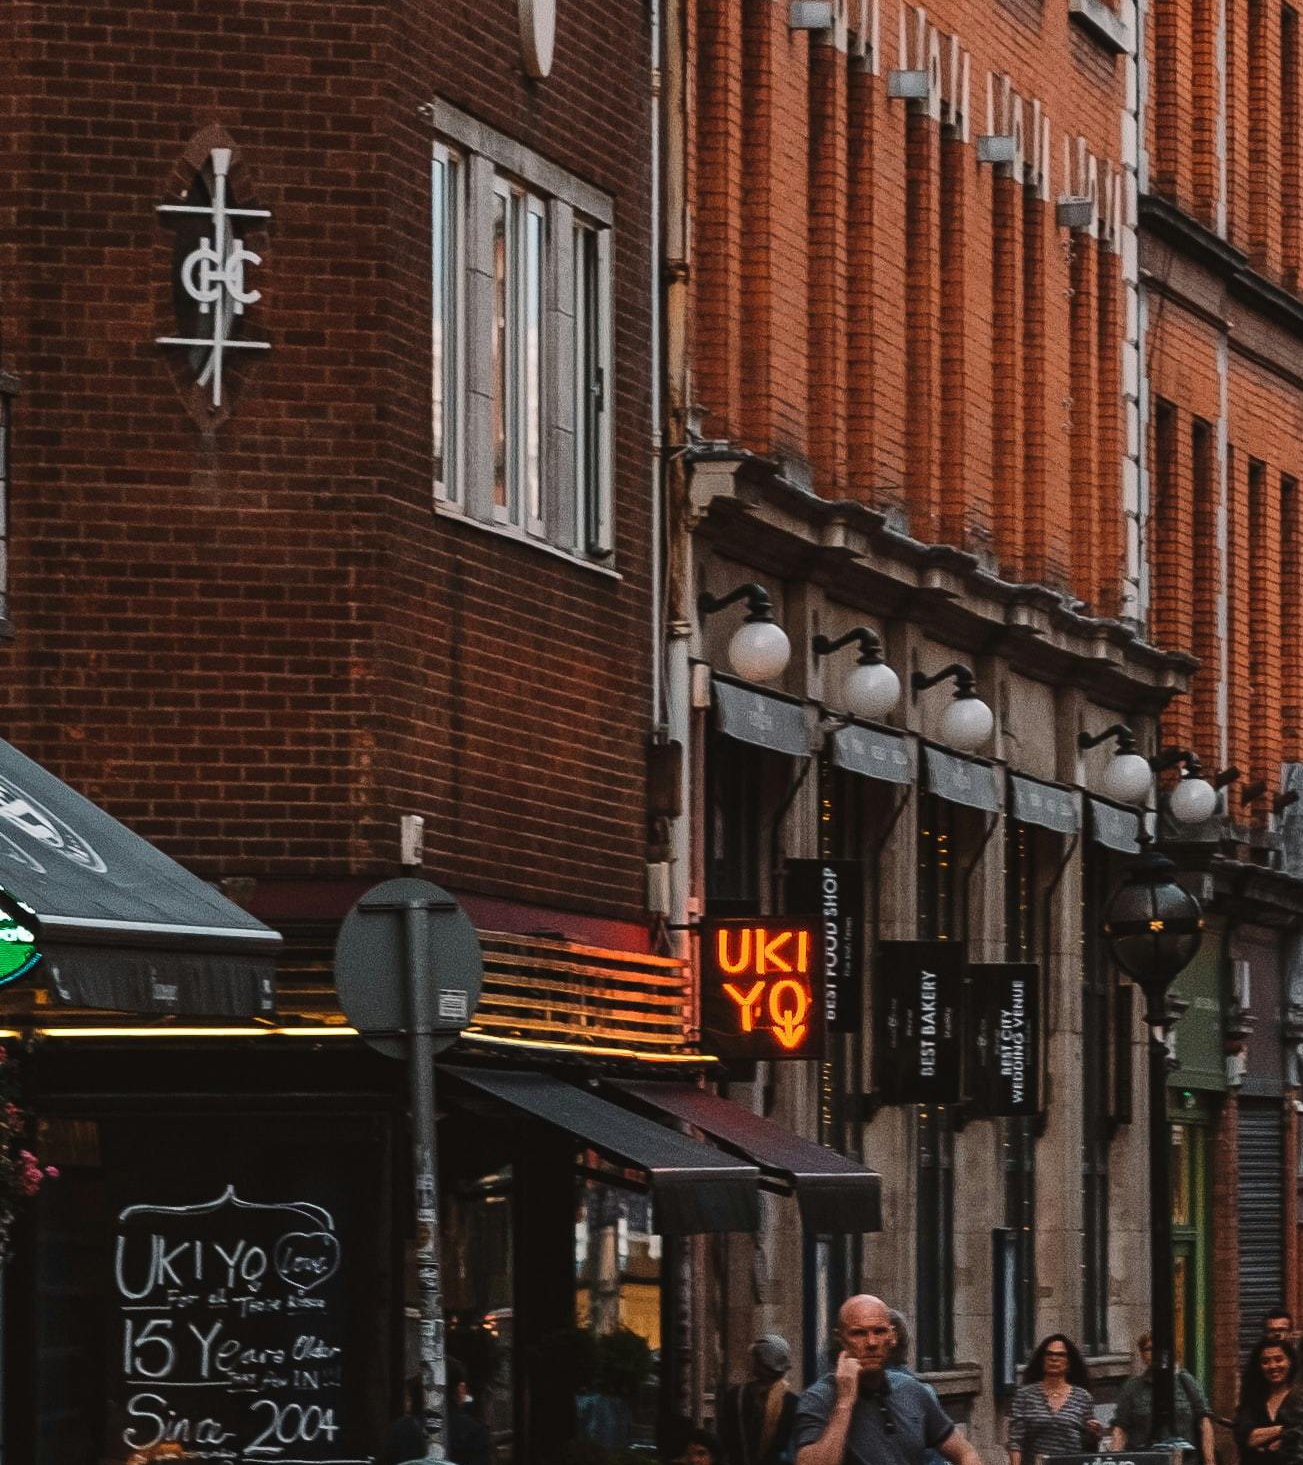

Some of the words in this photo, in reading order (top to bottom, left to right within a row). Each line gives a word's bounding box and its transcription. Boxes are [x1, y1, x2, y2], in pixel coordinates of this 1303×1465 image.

[823, 867, 838, 917] SHOP
[719, 928, 807, 973] UKI
[824, 922, 837, 976] FOOD
[920, 970, 937, 1035] BAKERY
[1012, 980, 1024, 1026] VENUE
[920, 1040, 936, 1076] BEST
[1012, 1033, 1024, 1103] WEDDING
[123, 1319, 177, 1378] 15
[188, 1319, 286, 1379] Years
[242, 1399, 340, 1455] 2004
